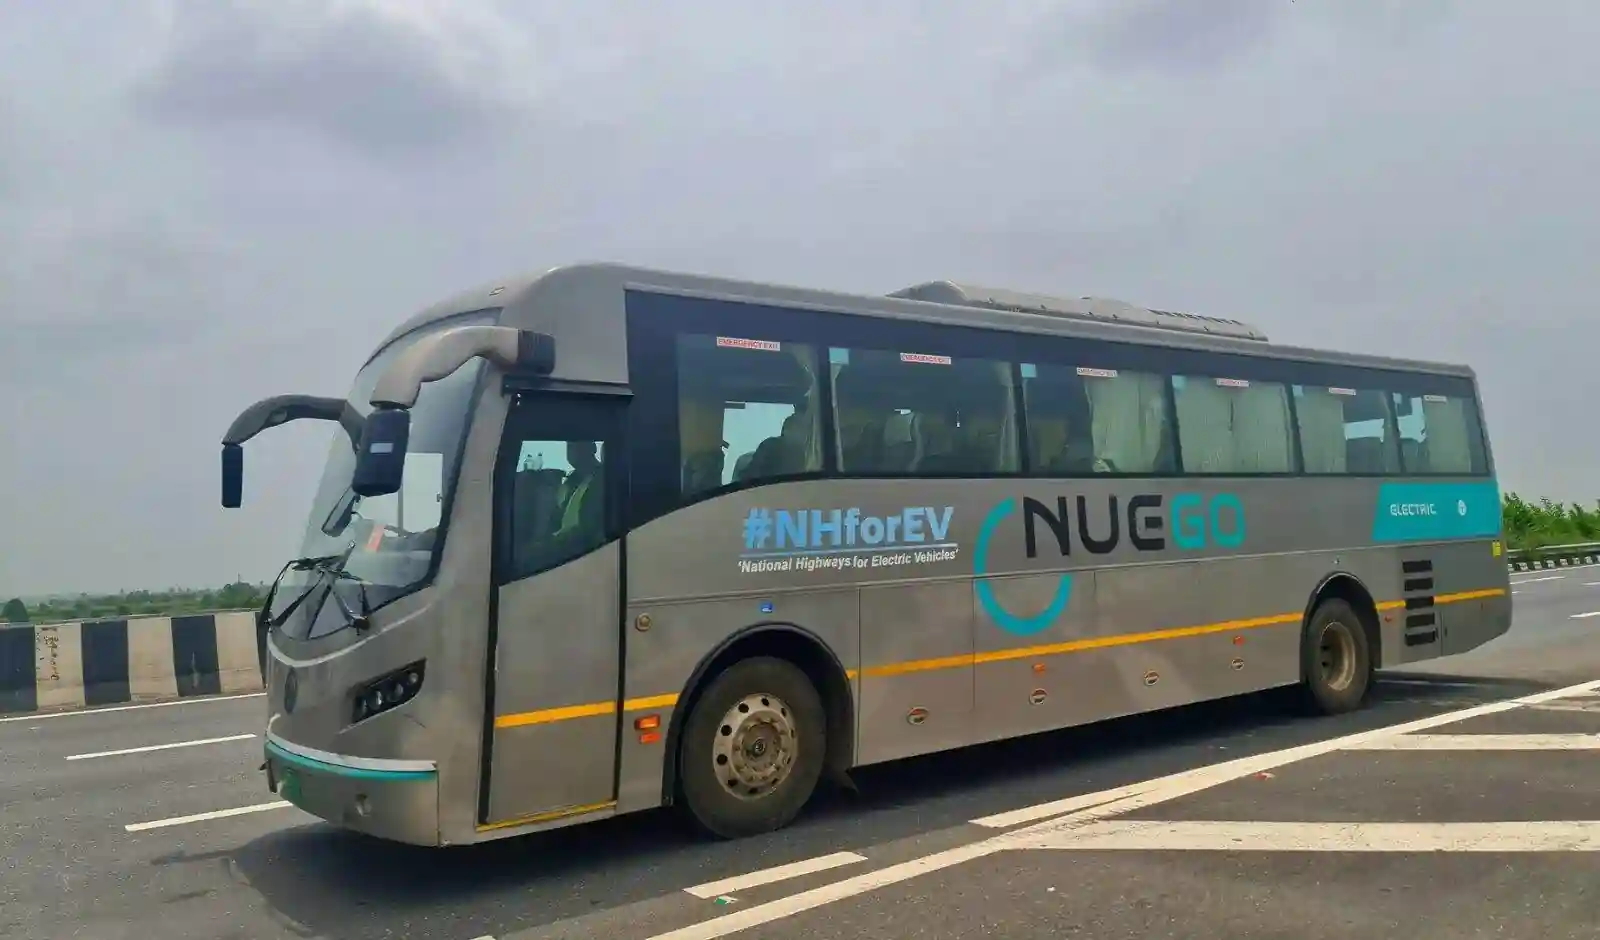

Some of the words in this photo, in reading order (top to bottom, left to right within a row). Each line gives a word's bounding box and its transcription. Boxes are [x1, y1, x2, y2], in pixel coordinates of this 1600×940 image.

[1390, 503, 1437, 516] ELECTRIC
[743, 507, 954, 549] #NHforEV
[1023, 492, 1246, 558] NUEGO
[796, 554, 851, 572] Highways
[852, 554, 868, 569] for
[871, 553, 912, 567] Electric
